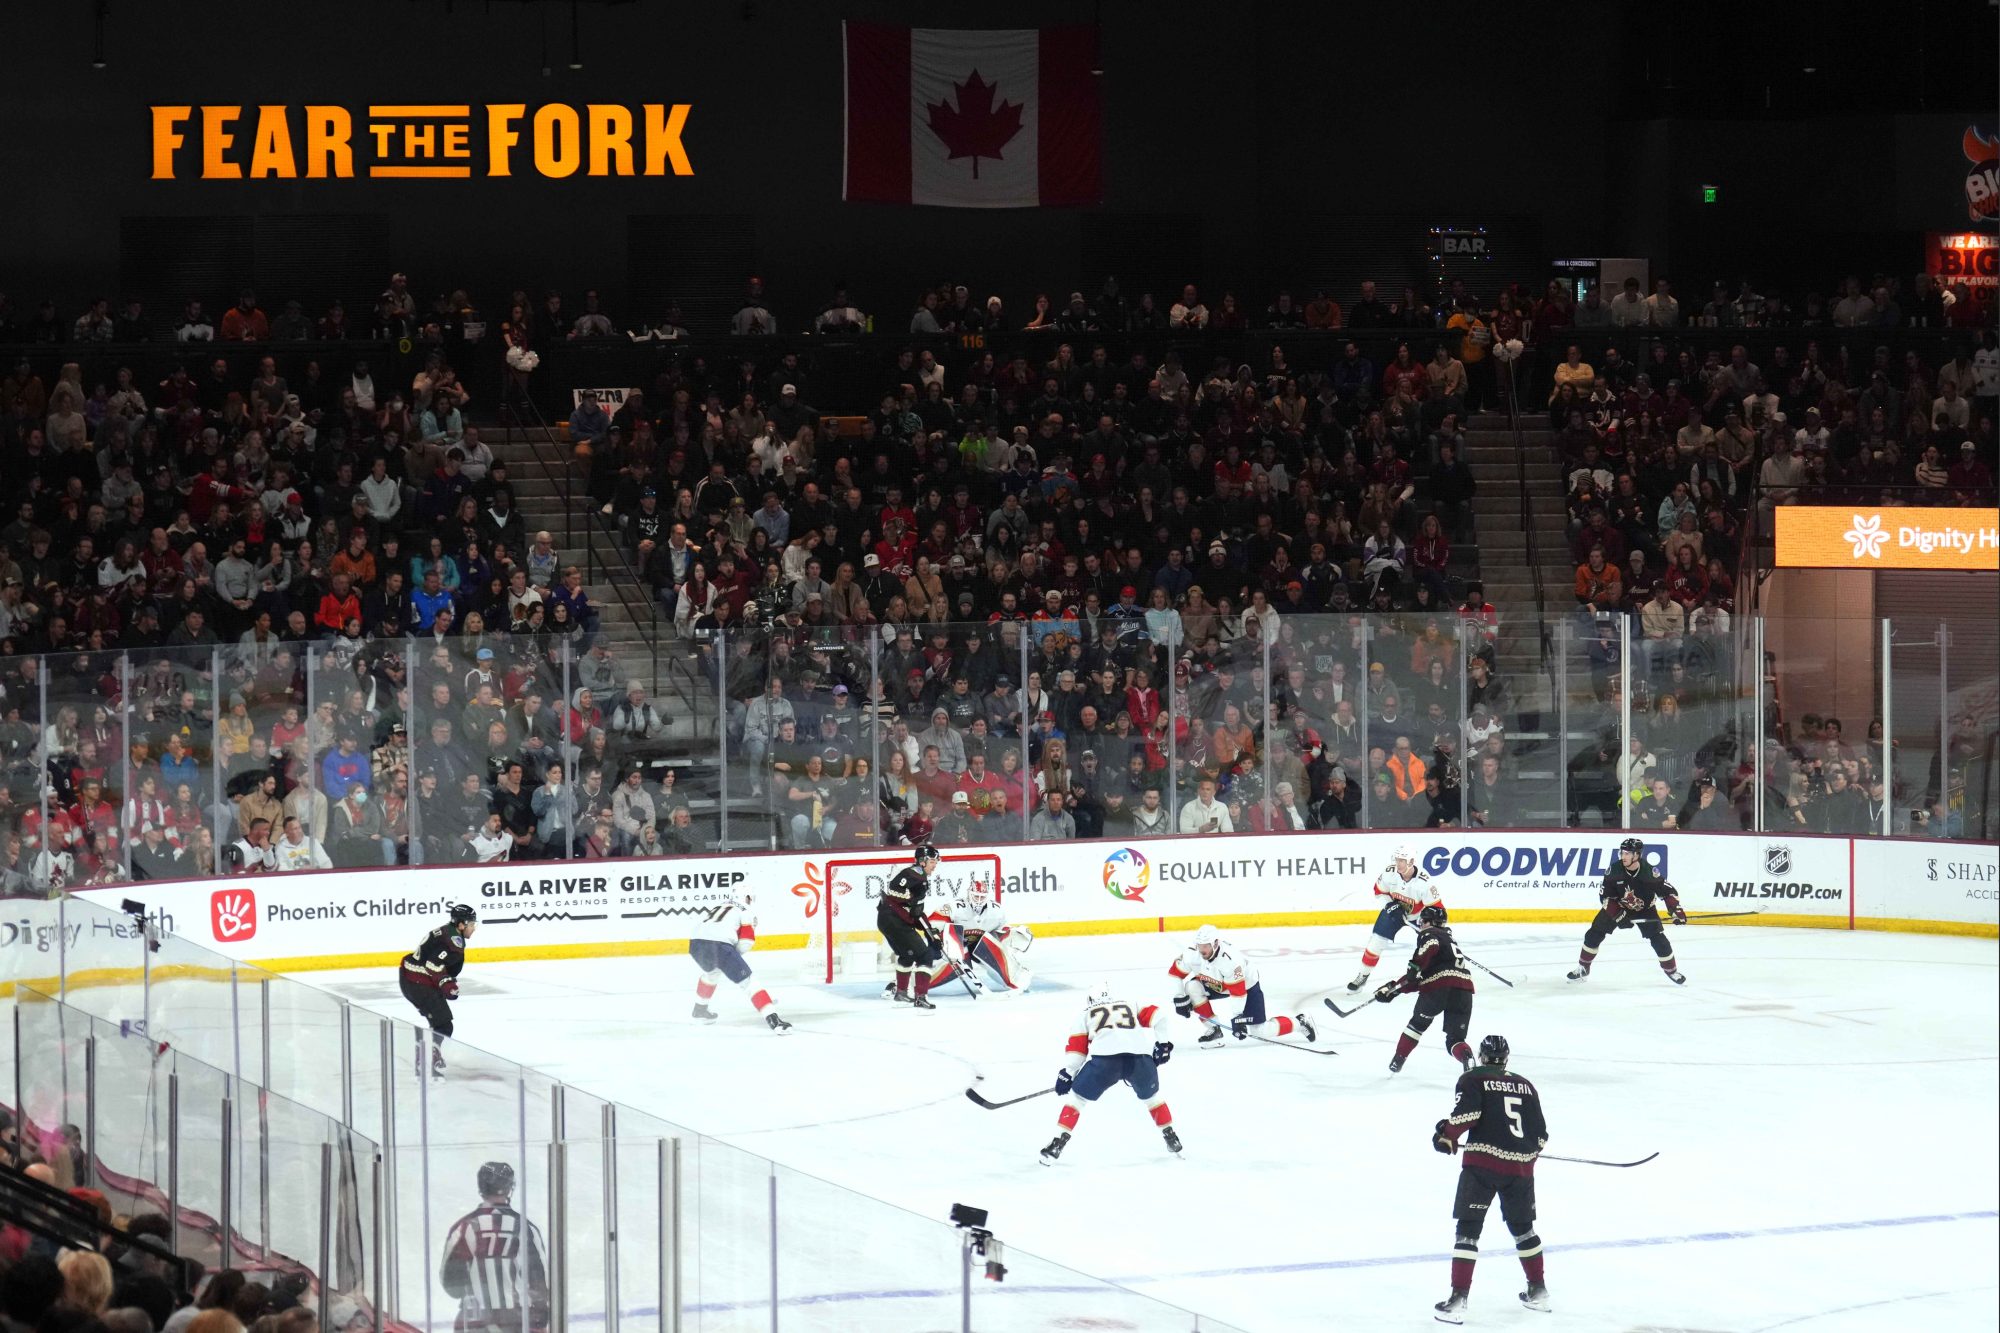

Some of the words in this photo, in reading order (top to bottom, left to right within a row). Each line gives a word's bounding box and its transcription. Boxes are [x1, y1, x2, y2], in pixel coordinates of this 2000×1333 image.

[150, 105, 355, 179] FEAR
[369, 124, 470, 158] THE
[485, 102, 695, 179] FORK
[1443, 237, 1486, 254] BAR
[1940, 235, 1965, 248] WE
[1968, 235, 1999, 248] ARE
[1940, 249, 1999, 276] BIG
[962, 334, 984, 350] 116
[1899, 527, 1975, 554] Dignity
[1159, 859, 1266, 882] EQUALITY
[1277, 856, 1366, 876] HEALTH
[1770, 853, 1788, 871] NHL
[481, 880, 534, 897] GILA
[539, 877, 608, 895] RIVER
[620, 875, 673, 891] GILA
[899, 877, 908, 887] 9
[1484, 879, 1492, 888] of
[1496, 879, 1530, 889] Central
[1532, 880, 1540, 888] &
[1543, 880, 1586, 889] Northern
[268, 902, 346, 922] Phoenix
[353, 896, 453, 918] Children's
[555, 898, 608, 907] CASINOS
[620, 896, 675, 904] RESORTS
[438, 951, 448, 960] 8
[1090, 1004, 1136, 1033] 23
[1503, 1096, 1524, 1139] 5
[481, 1232, 514, 1257] 77
